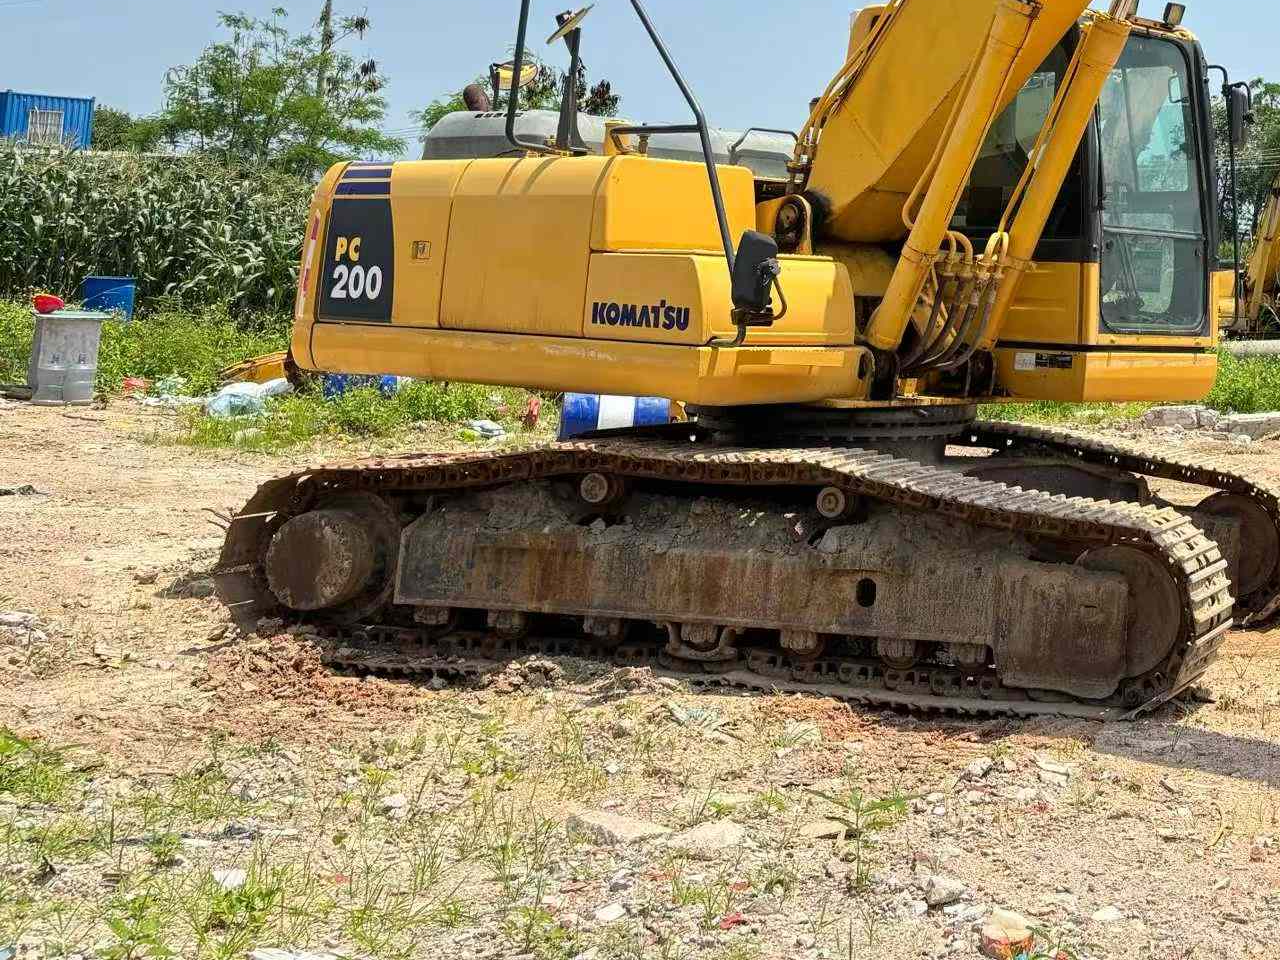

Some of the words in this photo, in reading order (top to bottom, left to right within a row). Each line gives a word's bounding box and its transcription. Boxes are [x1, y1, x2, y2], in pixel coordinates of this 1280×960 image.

[335, 236, 361, 262] PC
[330, 264, 382, 300] 200
[591, 299, 690, 331] KOMATSU
